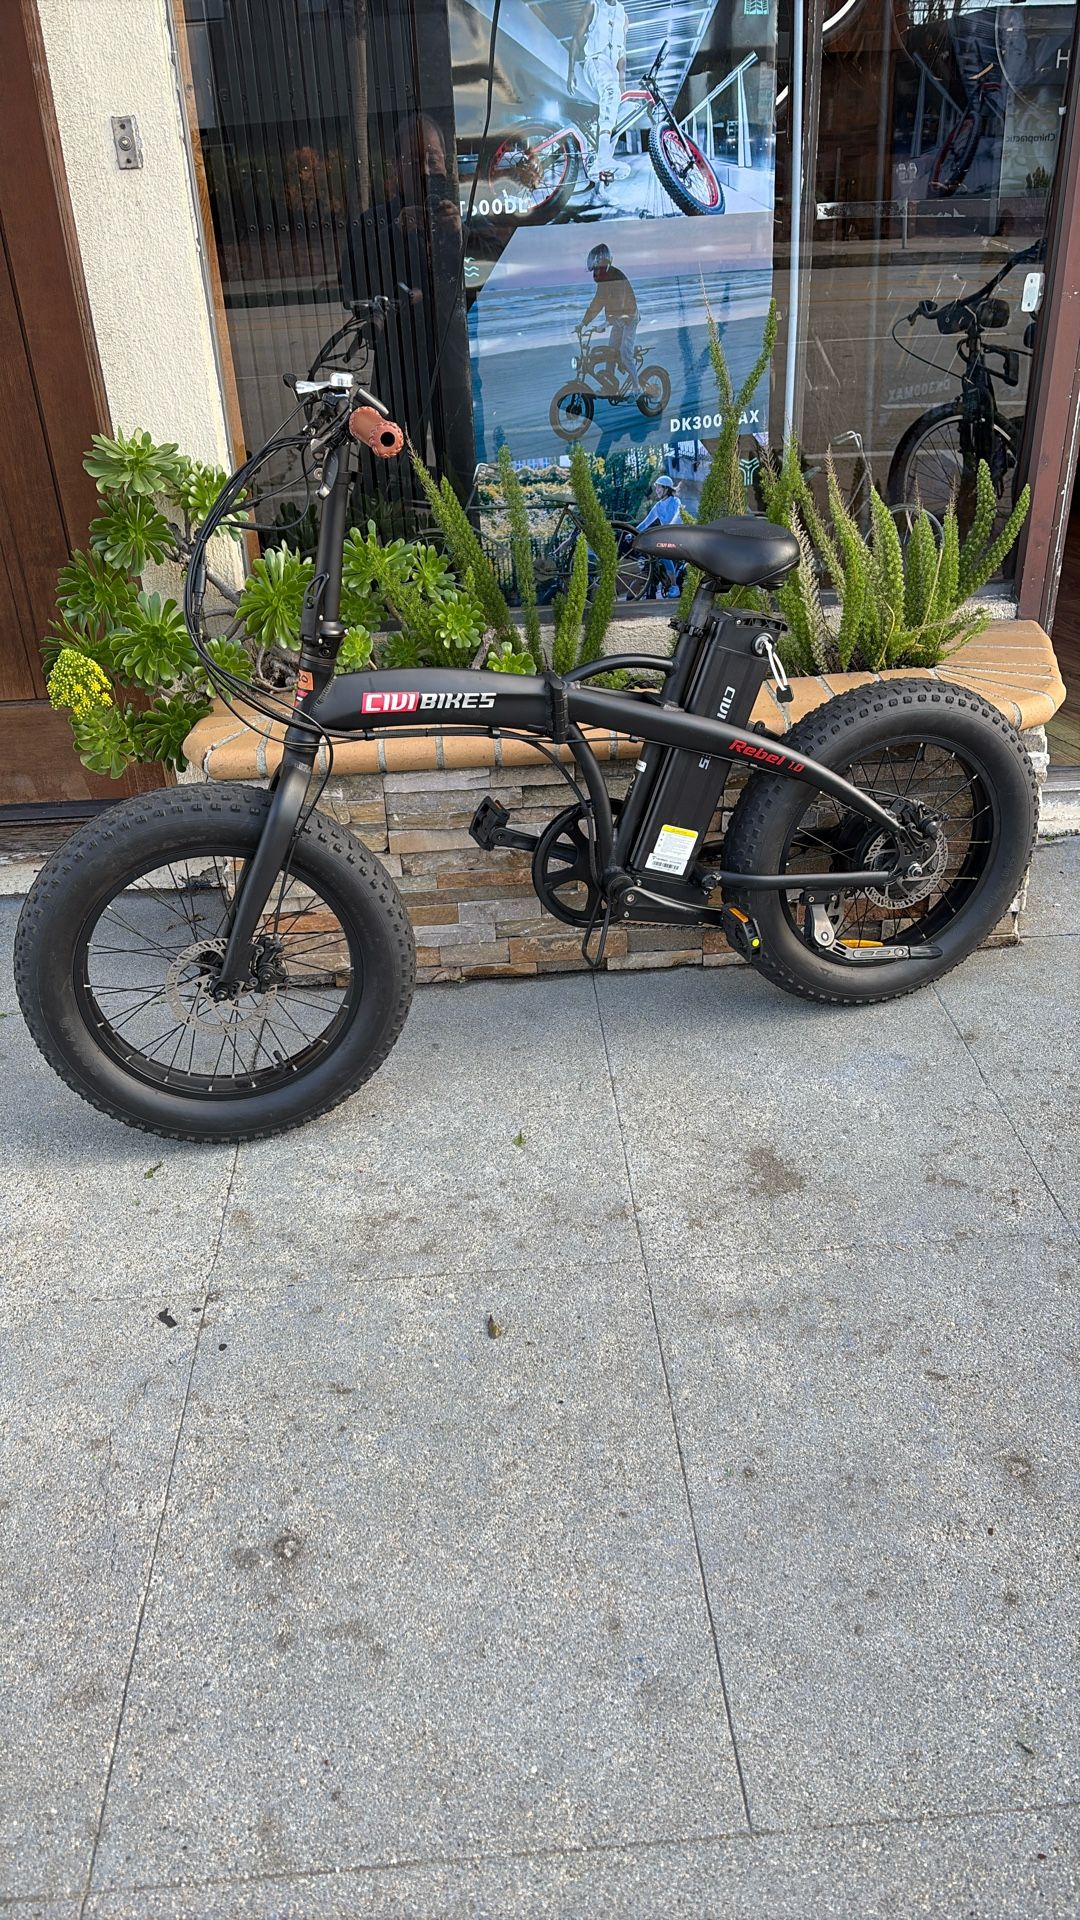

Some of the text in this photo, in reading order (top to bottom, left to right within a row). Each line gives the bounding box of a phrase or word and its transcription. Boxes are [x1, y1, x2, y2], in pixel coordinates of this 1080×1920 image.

[670, 409, 760, 432] DK300AX
[364, 692, 497, 712] CIVI BIKES
[717, 686, 736, 720] CIVI
[728, 739, 787, 766] Rebel
[787, 760, 805, 773] 1.0
